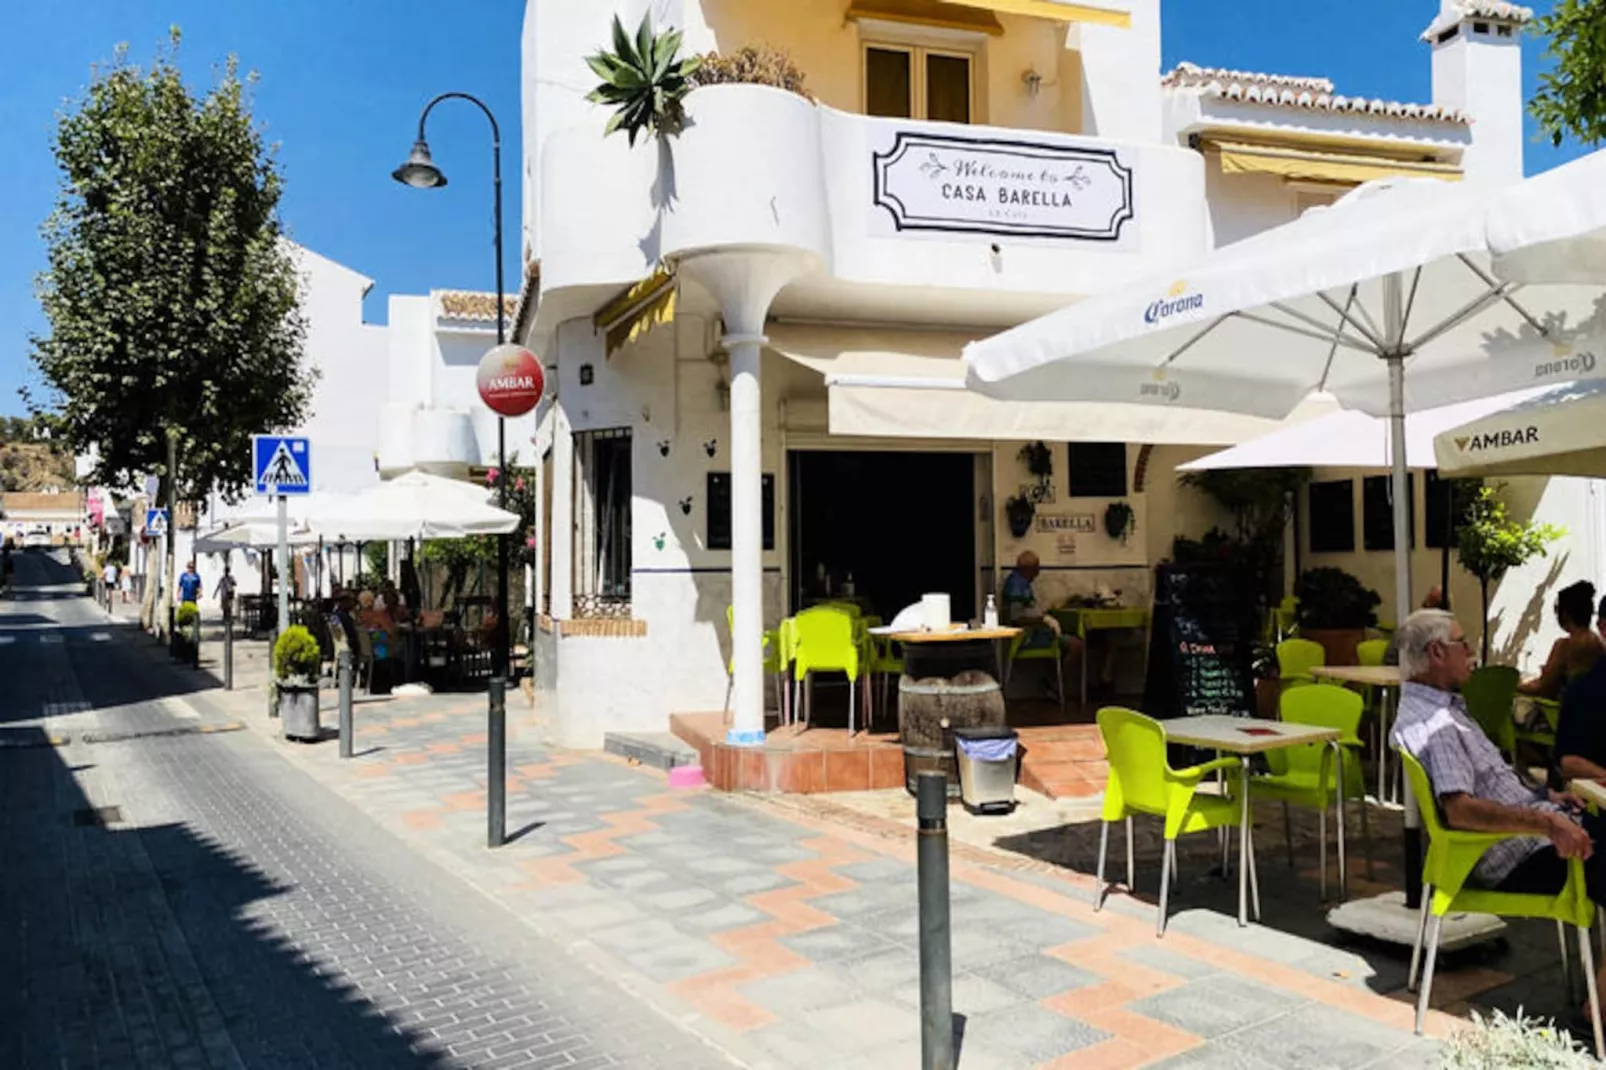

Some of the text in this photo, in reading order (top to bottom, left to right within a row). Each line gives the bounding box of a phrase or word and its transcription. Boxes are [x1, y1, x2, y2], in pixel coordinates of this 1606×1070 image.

[952, 158, 1059, 184] Welcome to
[941, 183, 1073, 208] CASA BARELLA
[1143, 292, 1204, 325] Corona
[487, 375, 536, 391] AMBAR
[1469, 425, 1540, 452] AMBAR
